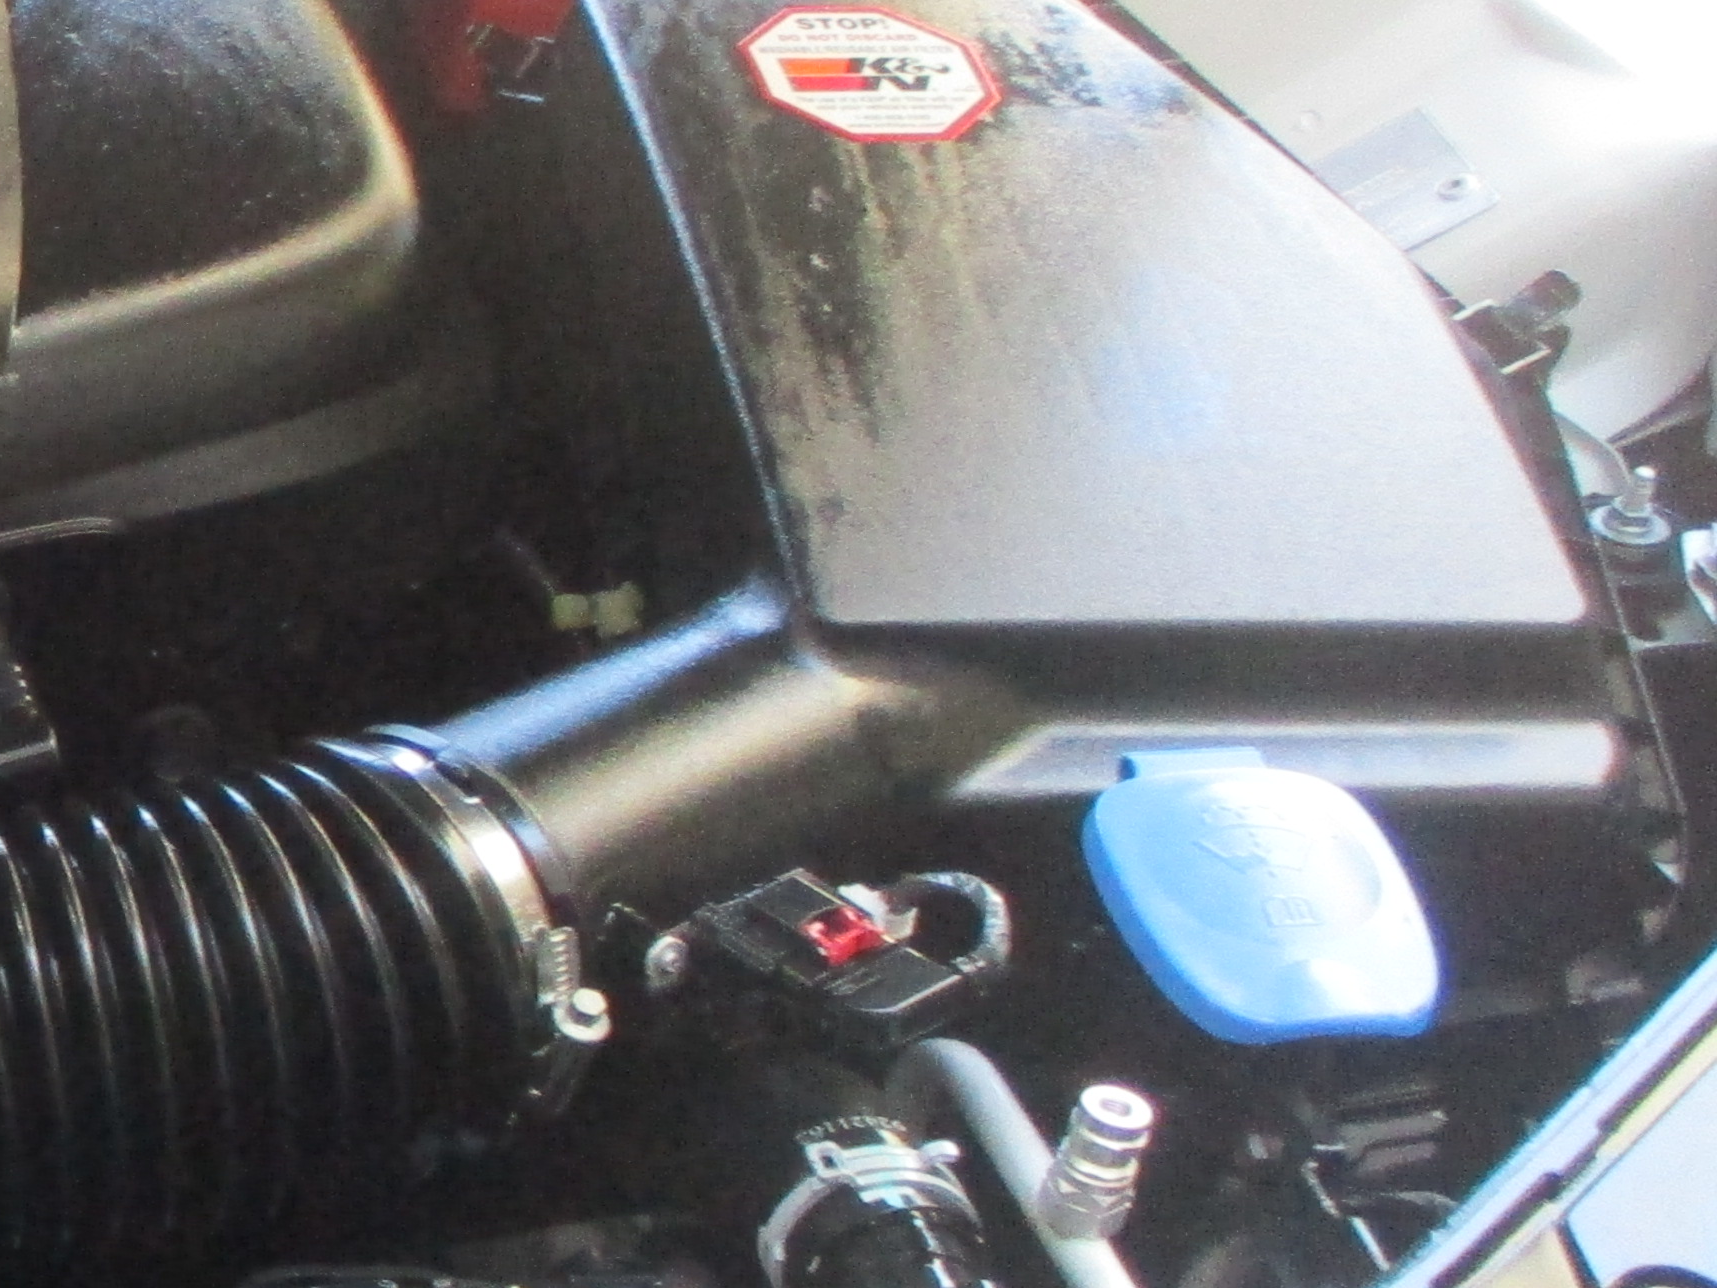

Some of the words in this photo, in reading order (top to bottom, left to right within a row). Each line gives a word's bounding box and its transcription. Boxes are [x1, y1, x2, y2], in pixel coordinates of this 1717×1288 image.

[795, 17, 890, 30] STOP!
[777, 34, 800, 42] DO
[806, 34, 838, 42] NOT
[845, 34, 919, 42] DISCARD
